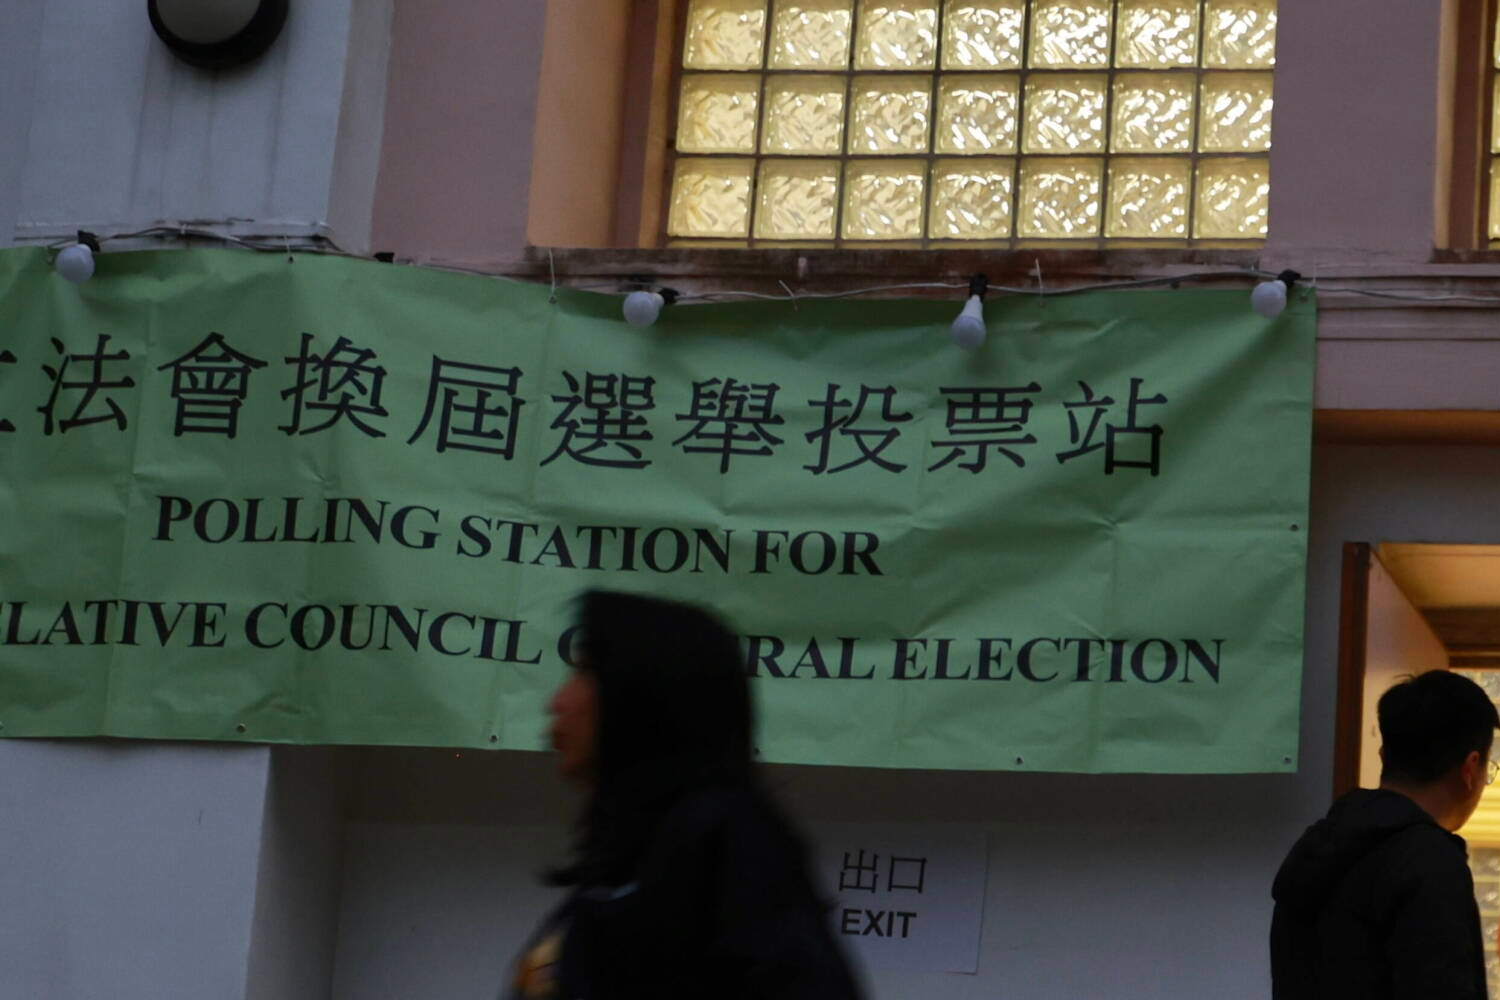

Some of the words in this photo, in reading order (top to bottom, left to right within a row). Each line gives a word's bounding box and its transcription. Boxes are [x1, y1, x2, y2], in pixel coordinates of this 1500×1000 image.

[0, 333, 1168, 477] 法會換屆選舉投票站
[155, 496, 441, 550] POLLING
[457, 516, 732, 575] STATION
[750, 530, 885, 576] FOR
[0, 600, 228, 646] LATIVE
[245, 602, 543, 666] COUNCIL
[891, 638, 1227, 684] ELECTION
[839, 849, 928, 893] 出口
[842, 908, 917, 938] EXIT
